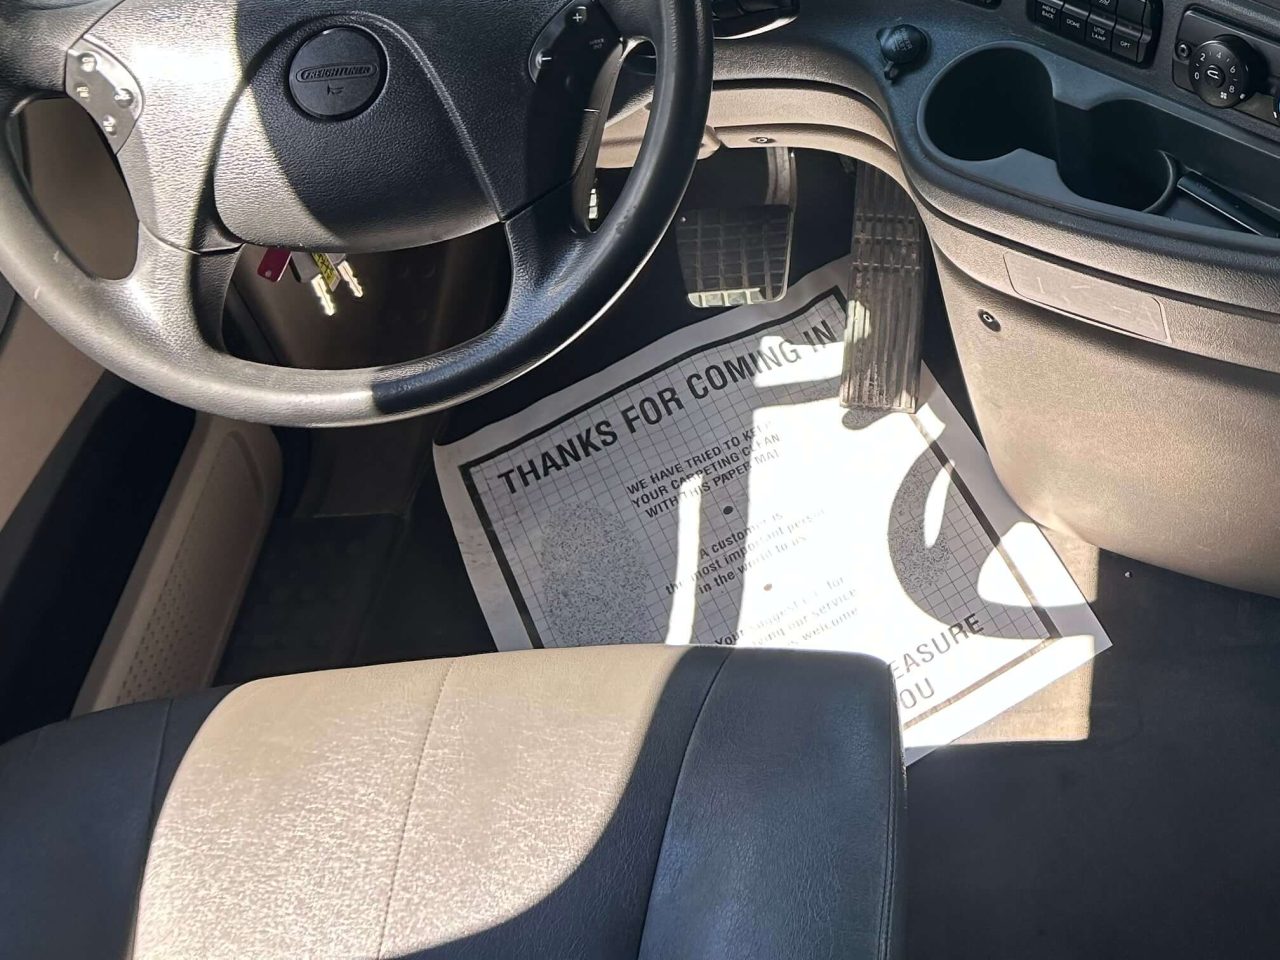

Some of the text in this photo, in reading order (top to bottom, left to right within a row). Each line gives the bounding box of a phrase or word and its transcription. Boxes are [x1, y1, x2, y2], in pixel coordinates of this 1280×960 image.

[1042, 11, 1054, 19] BACK
[1066, 19, 1080, 28] DOME
[1092, 32, 1106, 41] LAMP
[1120, 40, 1131, 48] OPT
[1200, 53, 1206, 61] 2
[1194, 72, 1200, 80] 0
[1229, 85, 1234, 93] 8
[497, 319, 835, 495] THANKS FOR COMING IN
[627, 479, 648, 495] WE
[650, 463, 684, 484] HAVE
[684, 446, 722, 470] TRIED
[724, 436, 740, 450] TO
[632, 484, 669, 509] YOUR
[671, 452, 740, 490] CARPETING
[646, 496, 679, 518] WITH
[713, 462, 752, 485] PAPER
[700, 549, 709, 559] A
[692, 560, 722, 582] most
[699, 583, 712, 594] in
[714, 570, 735, 587] the
[890, 613, 984, 679] EASURE
[899, 677, 935, 709] OU
